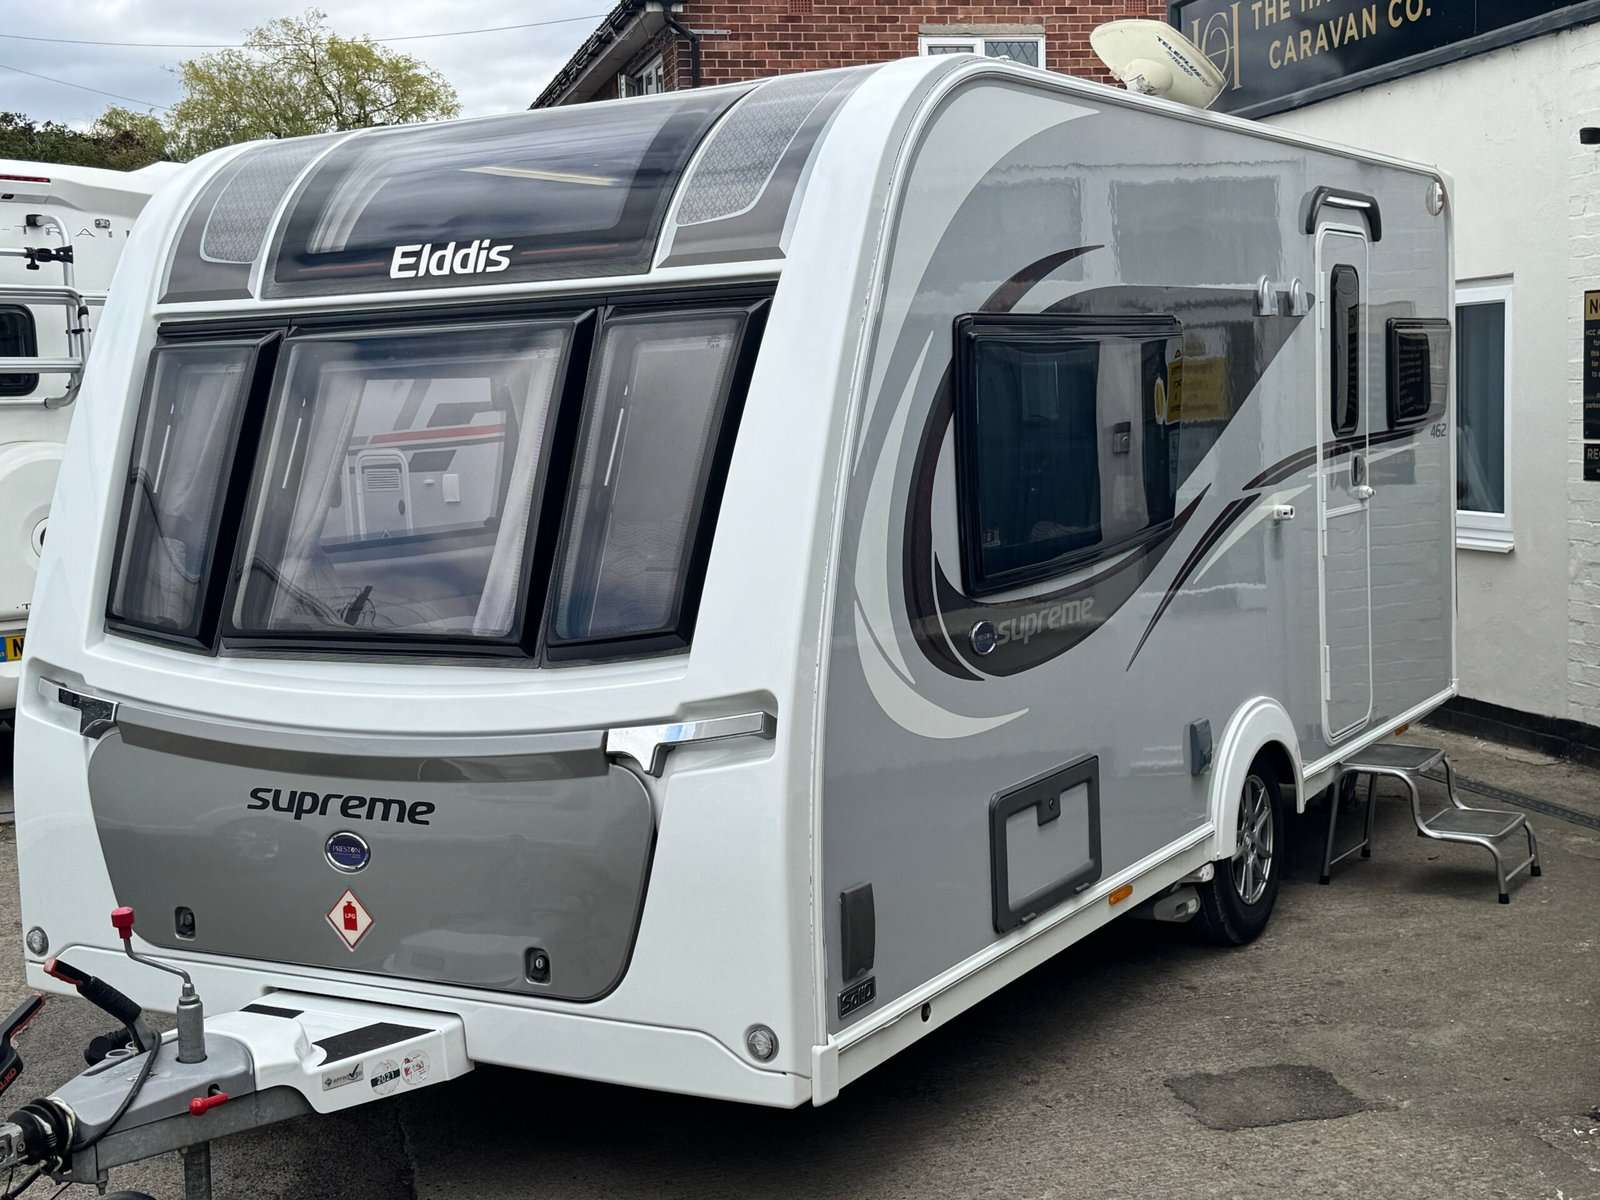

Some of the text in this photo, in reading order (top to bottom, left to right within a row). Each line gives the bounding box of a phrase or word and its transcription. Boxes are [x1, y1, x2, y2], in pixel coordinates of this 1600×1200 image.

[1251, 0, 1292, 31] THE
[1269, 4, 1377, 70] CARAVAN
[1387, 0, 1432, 28] CO.
[389, 239, 514, 279] Elddis
[1590, 299, 1600, 314] N
[1430, 423, 1447, 439] 462
[1587, 448, 1600, 460] RE
[996, 596, 1094, 644] supreme
[247, 787, 436, 826] supreme
[344, 912, 356, 920] LPG
